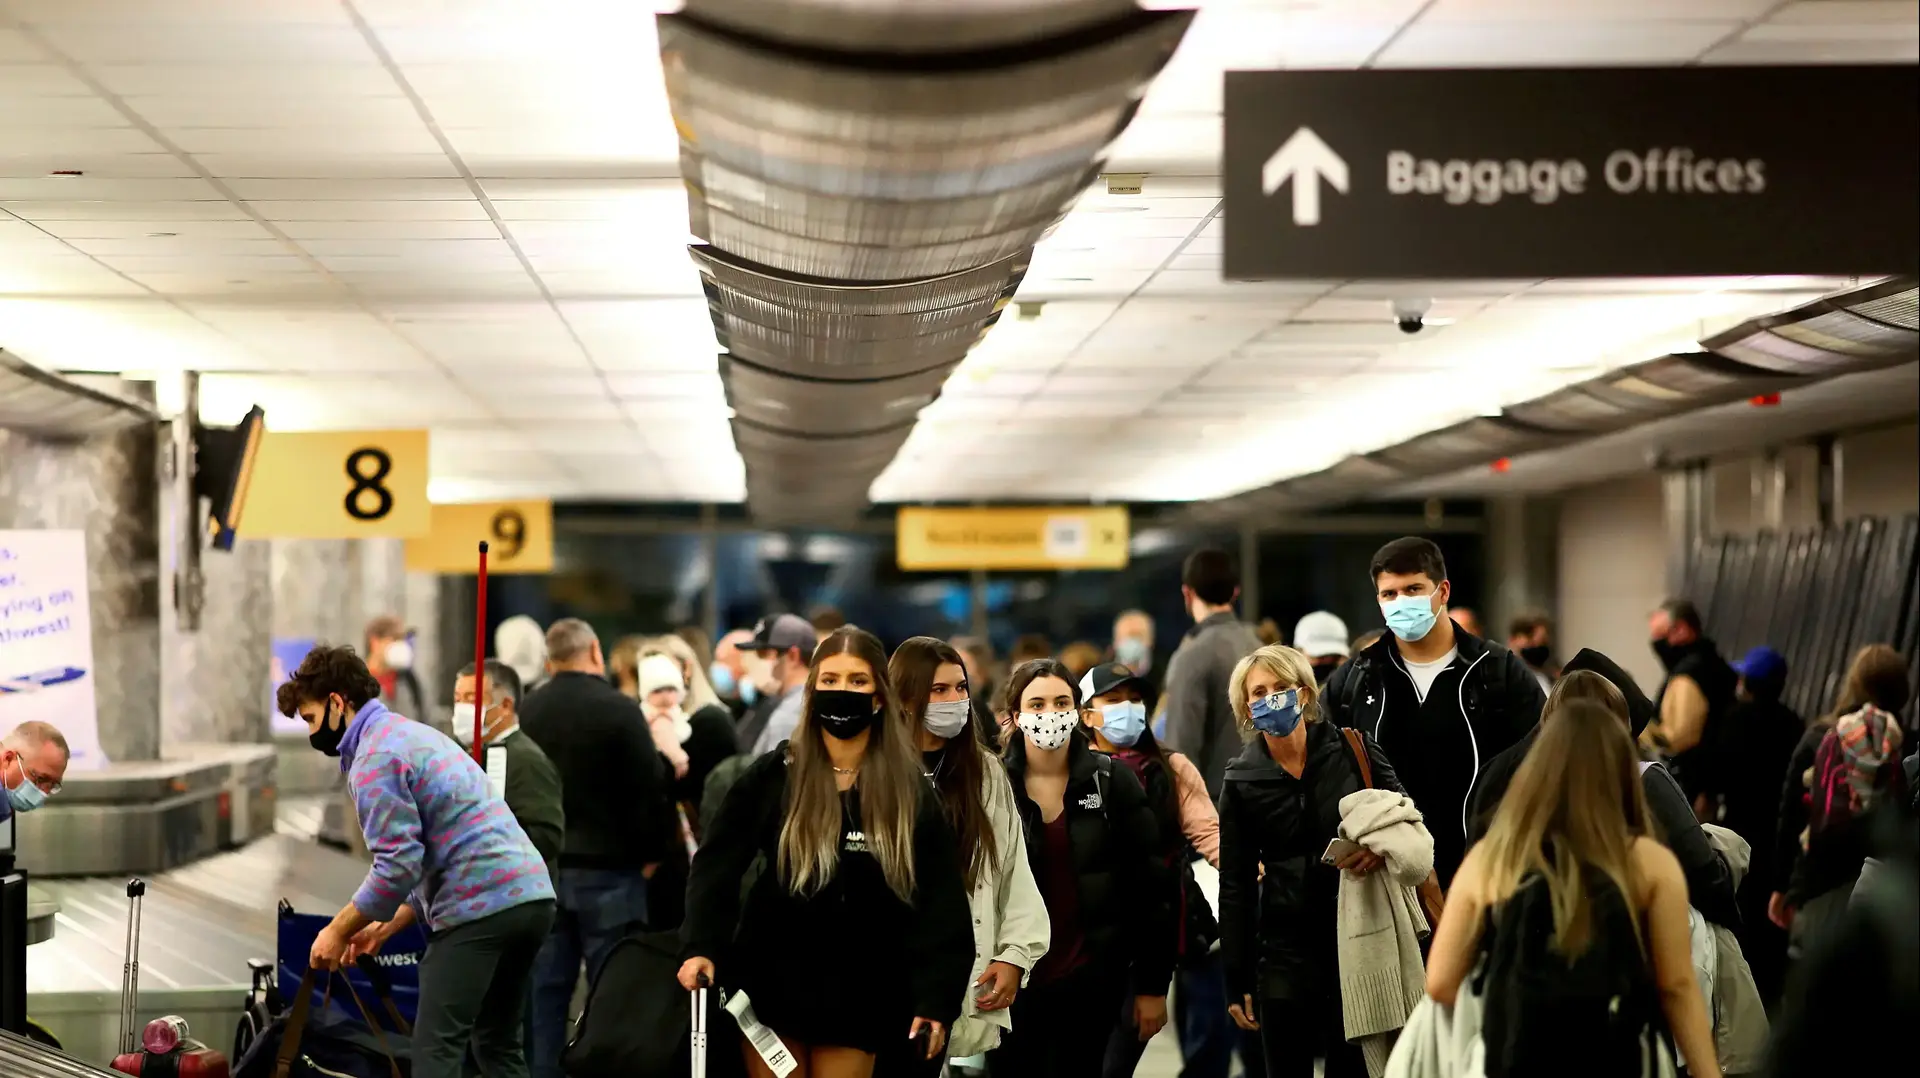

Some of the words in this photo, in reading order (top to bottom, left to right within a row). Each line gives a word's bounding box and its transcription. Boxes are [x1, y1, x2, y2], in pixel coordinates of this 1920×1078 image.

[1387, 150, 1587, 204] Baggage
[1604, 147, 1766, 193] Offices
[344, 446, 393, 521] 8
[491, 509, 527, 562] 9
[0, 596, 43, 619] ying
[0, 615, 70, 643] thwest!
[769, 1050, 786, 1066] DEN
